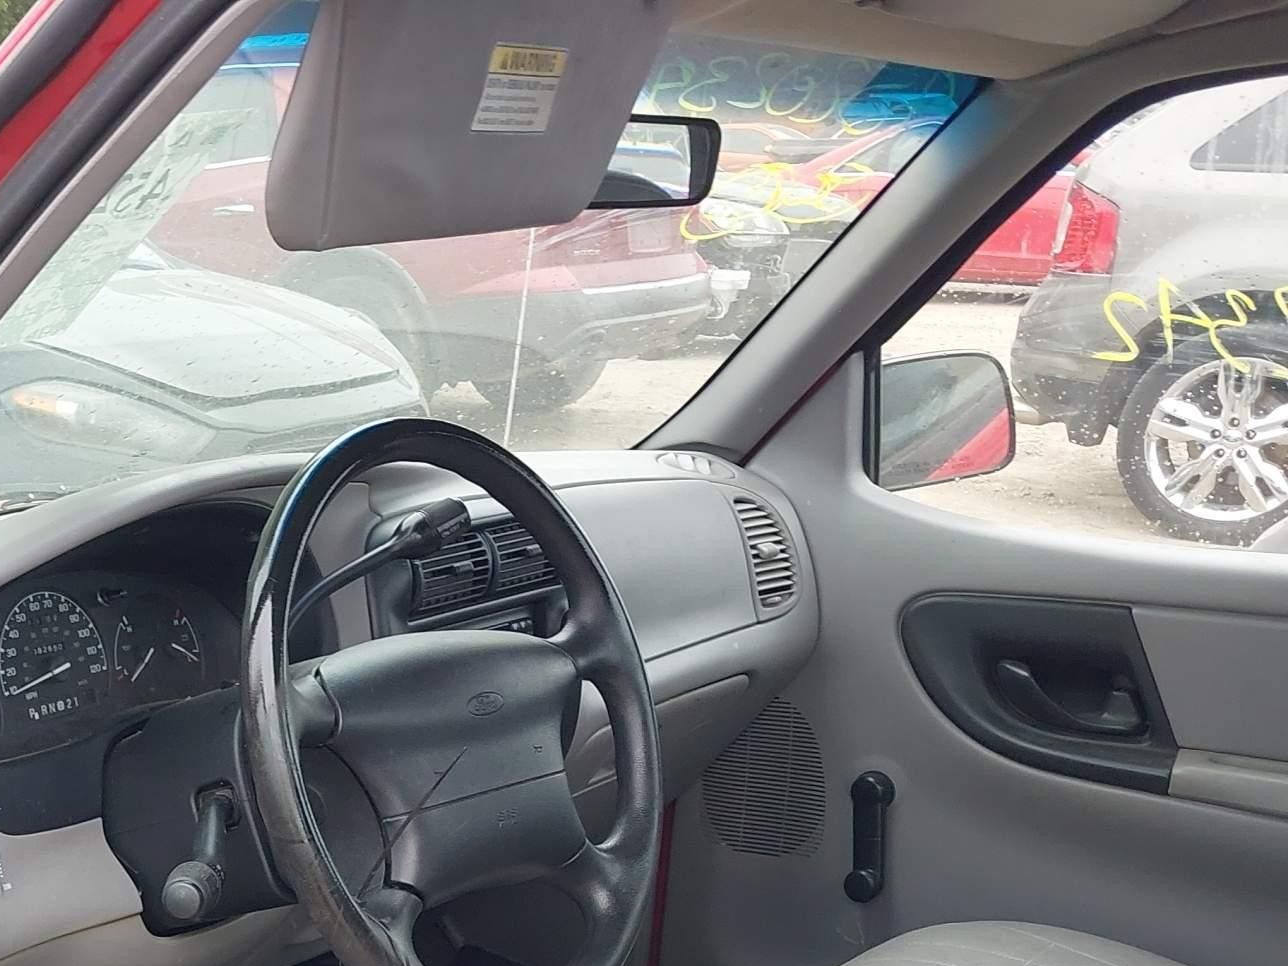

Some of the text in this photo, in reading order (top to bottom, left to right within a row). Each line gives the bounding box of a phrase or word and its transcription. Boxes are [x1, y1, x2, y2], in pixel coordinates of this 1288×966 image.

[509, 50, 559, 73] WARNING
[28, 602, 40, 612] 60
[42, 599, 53, 608] 70
[15, 612, 27, 623] 50
[9, 629, 20, 639] 40
[77, 628, 91, 638] 100
[6, 647, 17, 658] 30
[5, 666, 17, 677] 20
[89, 663, 102, 674] 120
